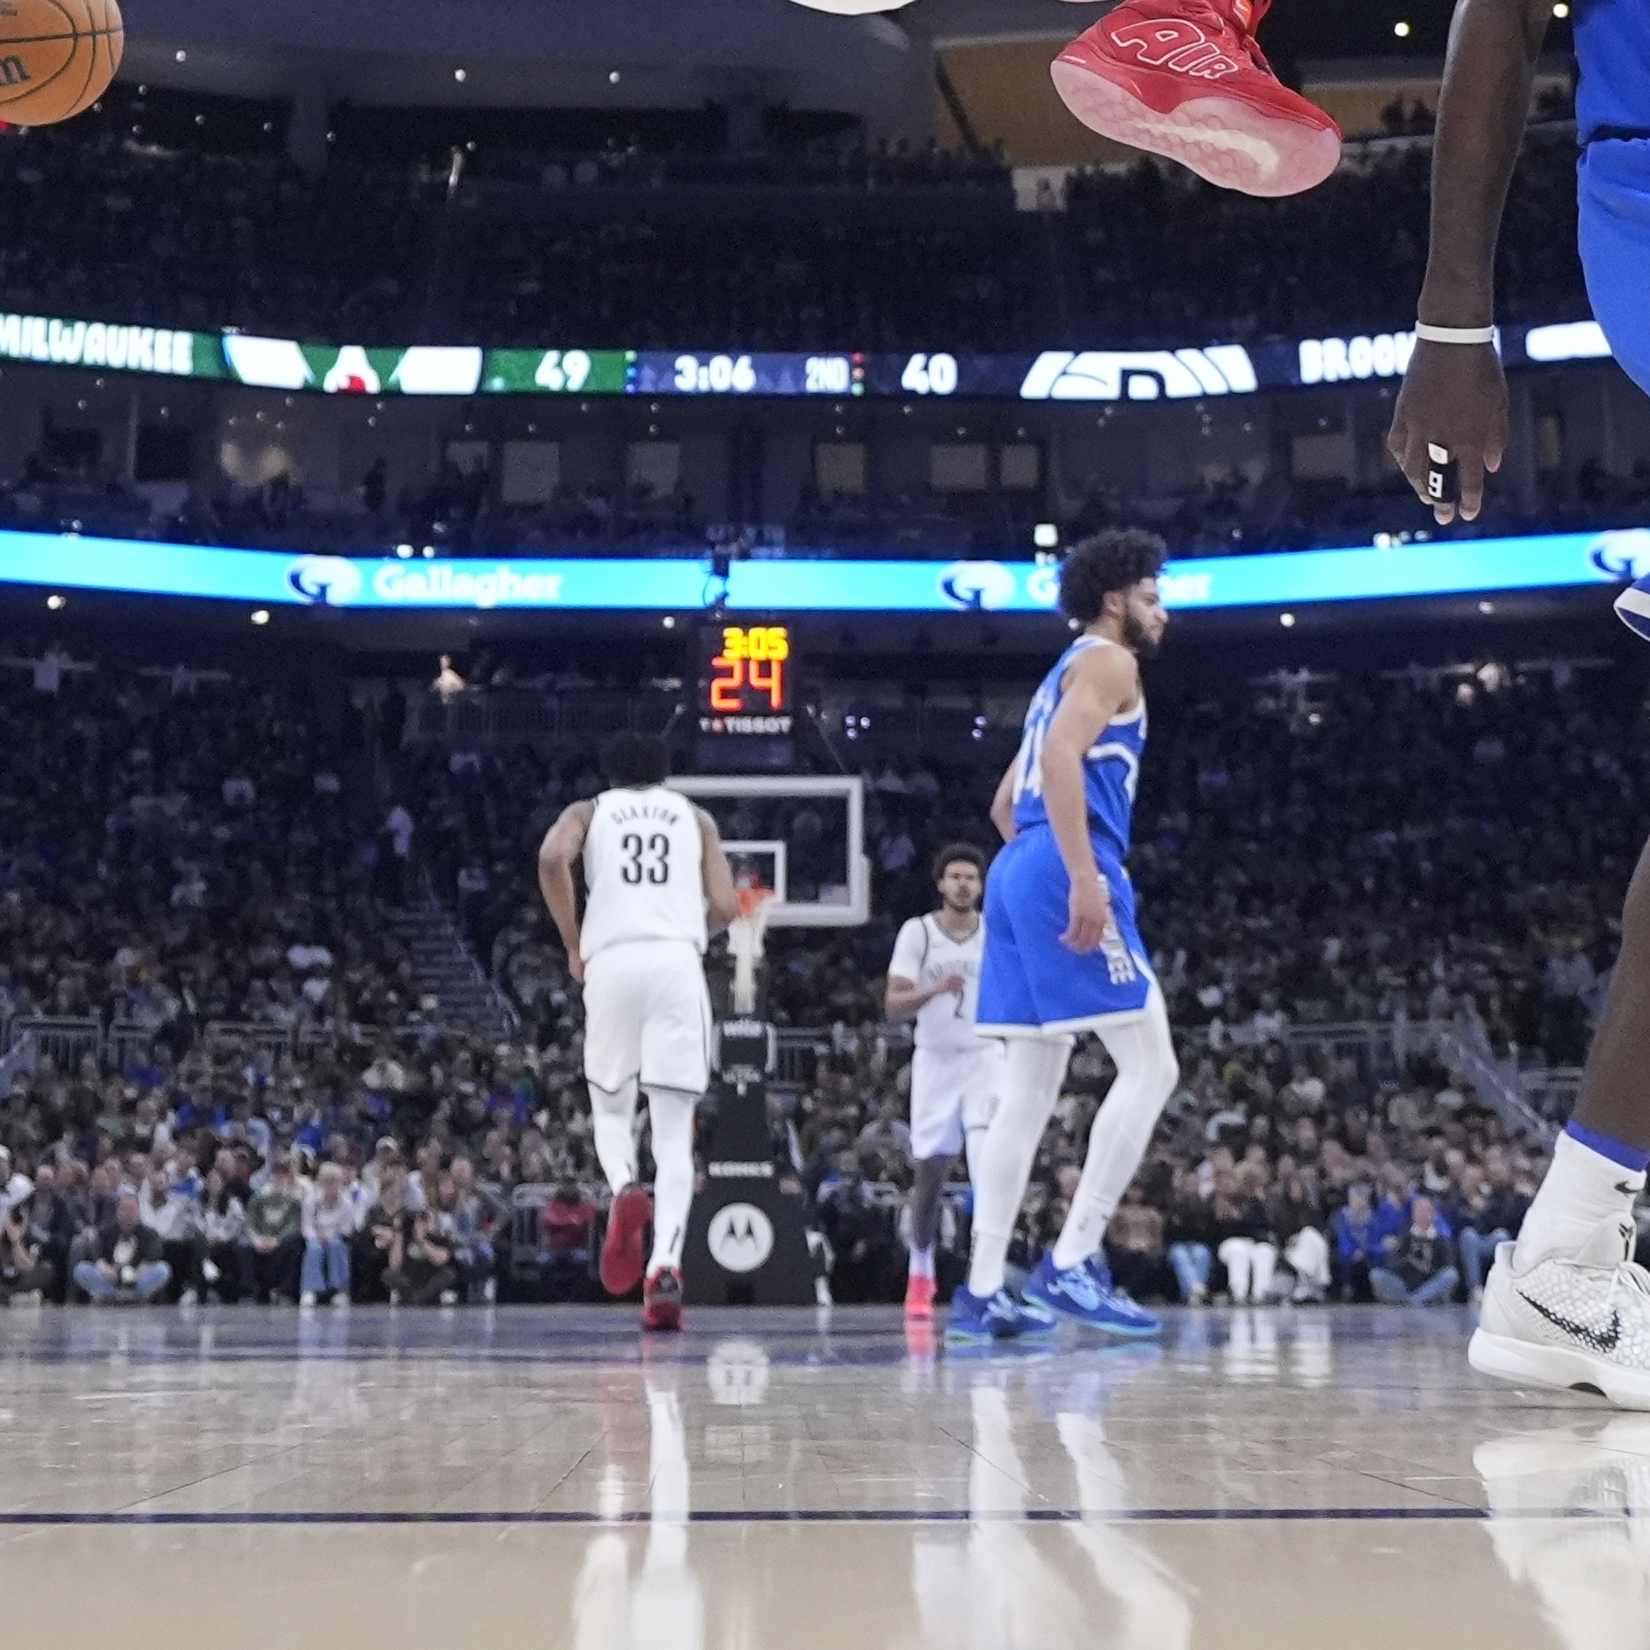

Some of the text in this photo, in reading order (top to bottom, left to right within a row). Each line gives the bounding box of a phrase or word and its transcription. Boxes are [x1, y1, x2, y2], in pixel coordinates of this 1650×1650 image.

[1111, 18, 1238, 81] AIR
[535, 349, 592, 392] 49
[674, 354, 758, 393] 3:06
[806, 356, 849, 392] 2ND
[901, 353, 958, 394] 40
[1299, 330, 1418, 384] BROOK
[1427, 469, 1444, 499] 9
[372, 563, 563, 609] Gallagher
[722, 626, 789, 661] 3:05
[710, 655, 783, 711] 24
[620, 832, 670, 885] 33
